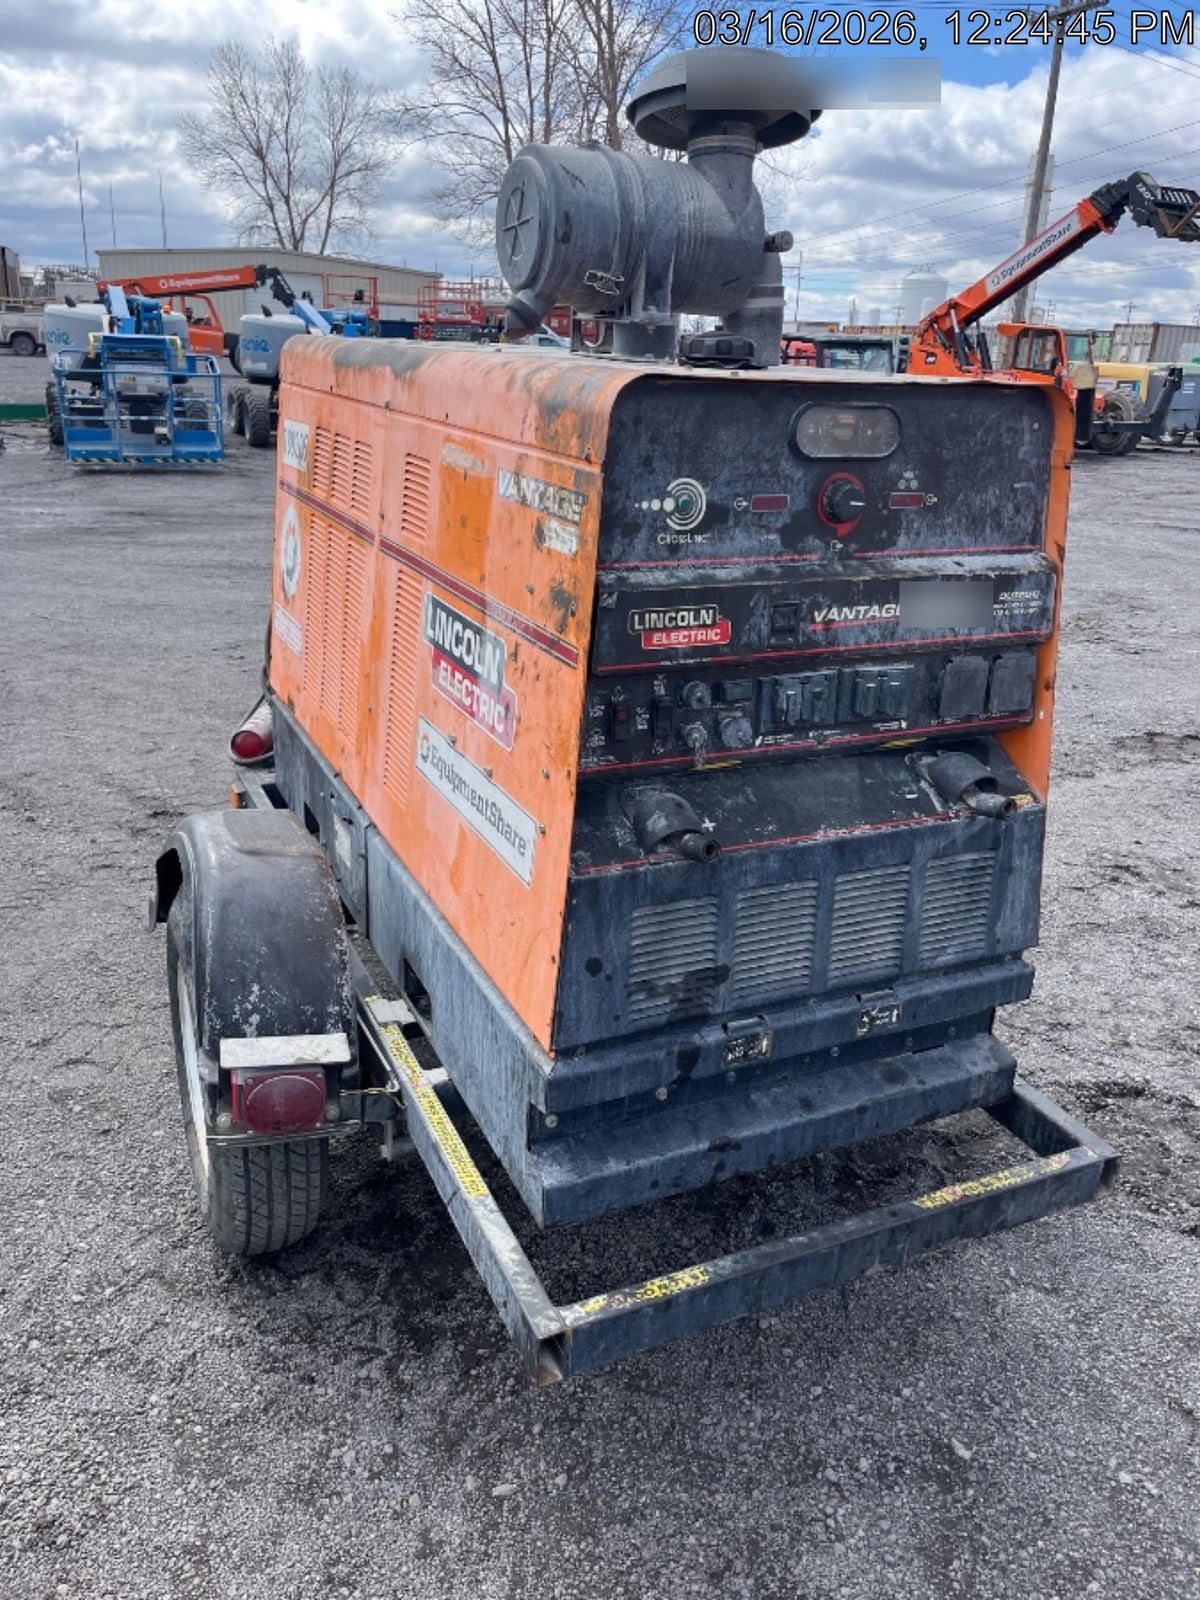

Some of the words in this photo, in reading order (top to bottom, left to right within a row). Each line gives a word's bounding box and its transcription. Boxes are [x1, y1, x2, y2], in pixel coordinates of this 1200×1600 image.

[1000, 223, 1073, 281] EquipmentShare
[168, 274, 240, 289] EquipmentShare
[426, 600, 502, 686] LINCOLN
[634, 608, 714, 630] LINCOLN
[652, 628, 721, 645] ELECTRIC
[438, 659, 506, 734] ELECTRIC
[429, 744, 528, 858] EquipmentShare
